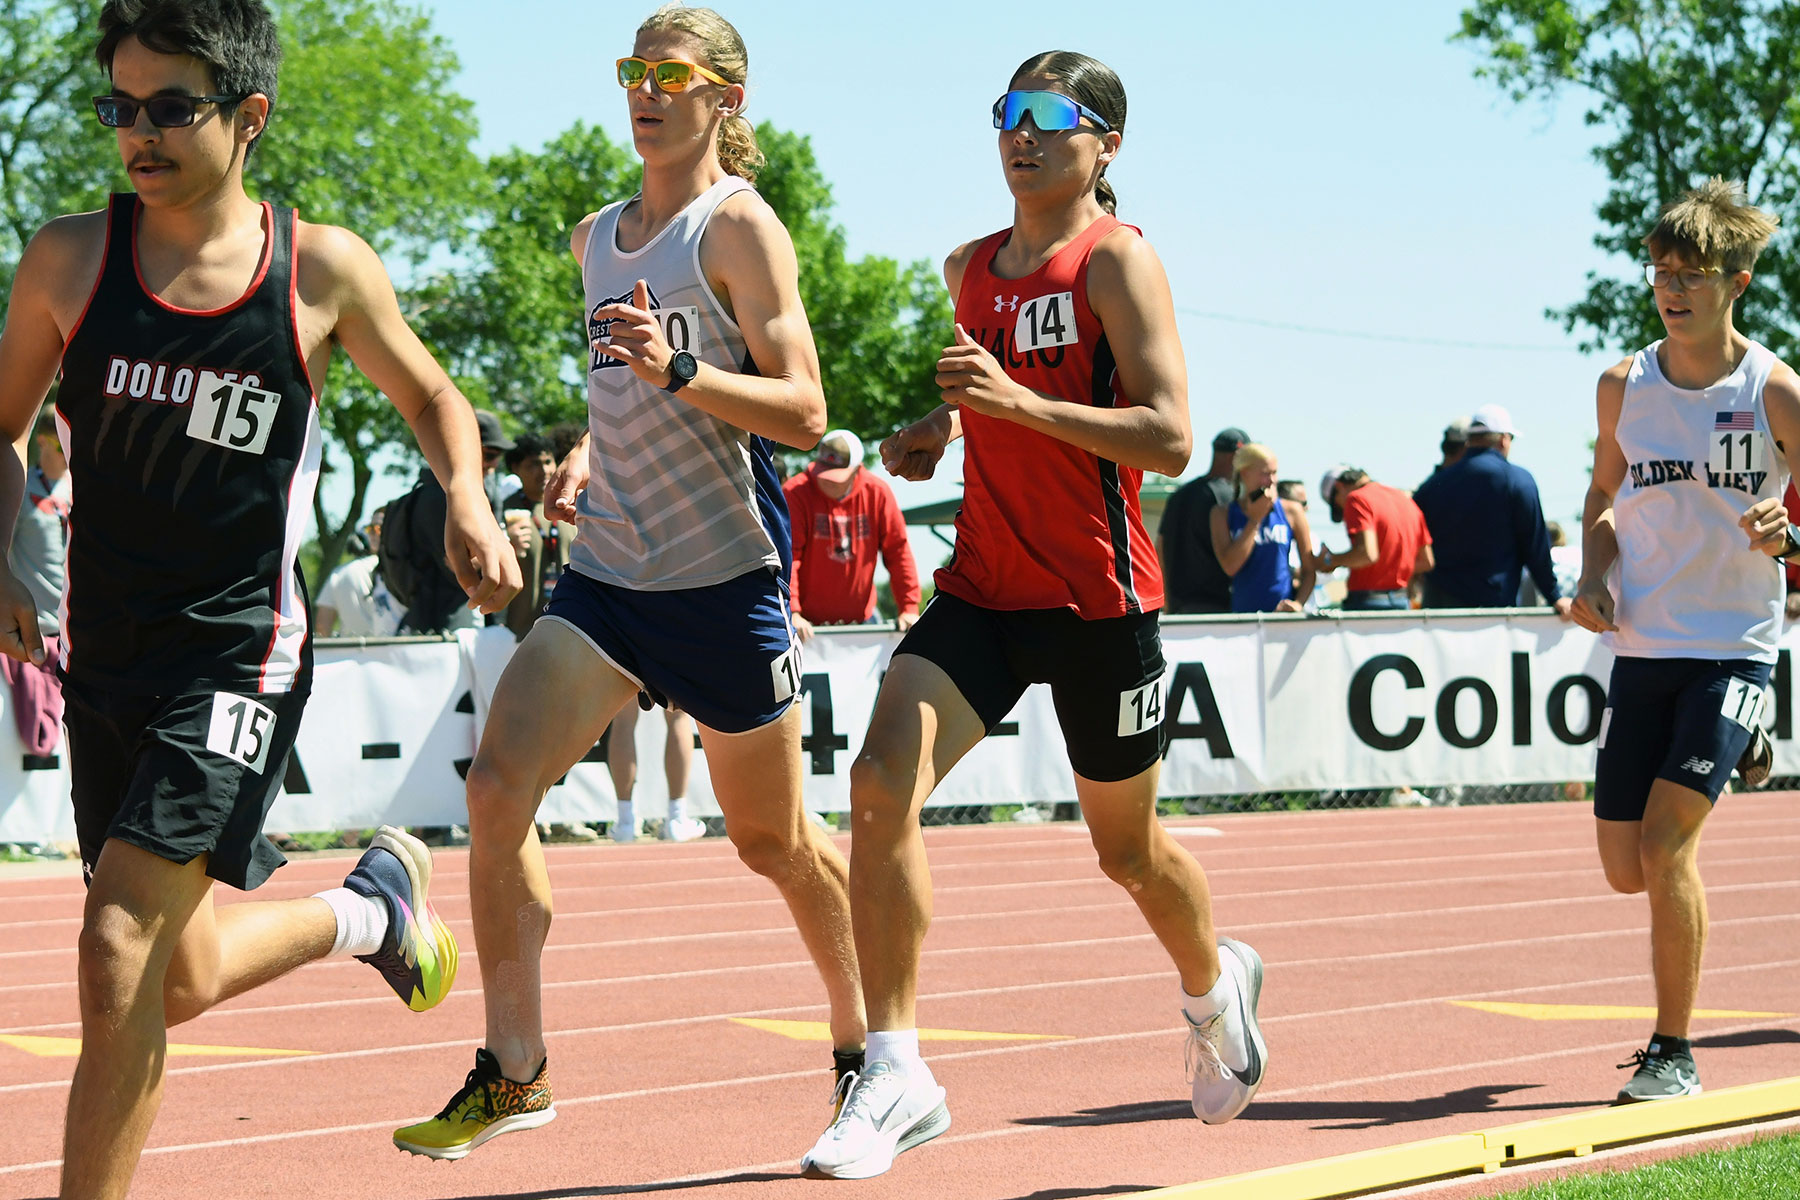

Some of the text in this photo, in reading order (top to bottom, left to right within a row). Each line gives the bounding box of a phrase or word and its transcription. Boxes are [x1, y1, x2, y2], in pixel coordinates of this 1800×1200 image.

[1025, 296, 1066, 346] 14
[104, 355, 262, 408] DOLO
[210, 384, 267, 448] 15
[1719, 432, 1753, 471] 11
[1130, 681, 1161, 732] 14
[1737, 683, 1760, 727] 11
[227, 700, 269, 764] 15
